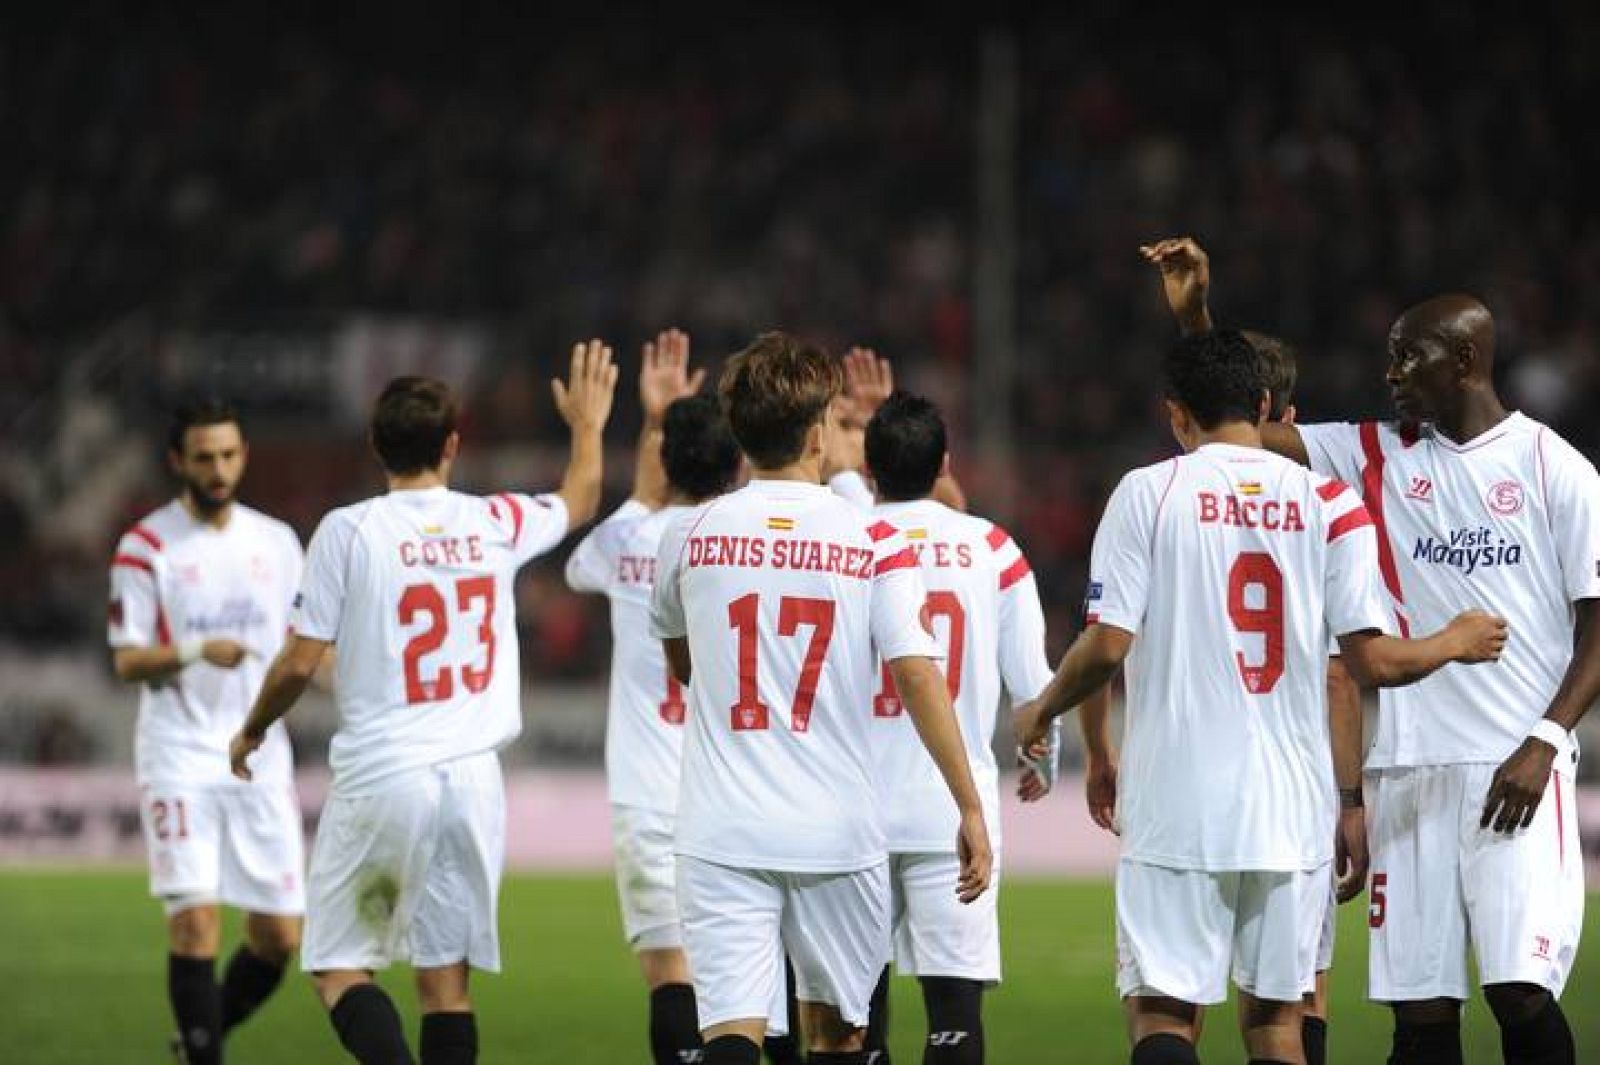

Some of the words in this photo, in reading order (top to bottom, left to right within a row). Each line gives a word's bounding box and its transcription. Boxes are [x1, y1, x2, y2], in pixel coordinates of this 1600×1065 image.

[1198, 491, 1305, 532] BACCA
[400, 535, 484, 568] COKE
[688, 535, 765, 568] DENIS
[771, 538, 874, 579] SUAREZ
[1413, 537, 1521, 574] Maaysia
[1450, 527, 1492, 547] Visit
[398, 575, 496, 705] 23
[1228, 551, 1284, 695] 9
[728, 592, 836, 733] 17
[152, 799, 190, 842] 21
[1368, 873, 1388, 929] 5
